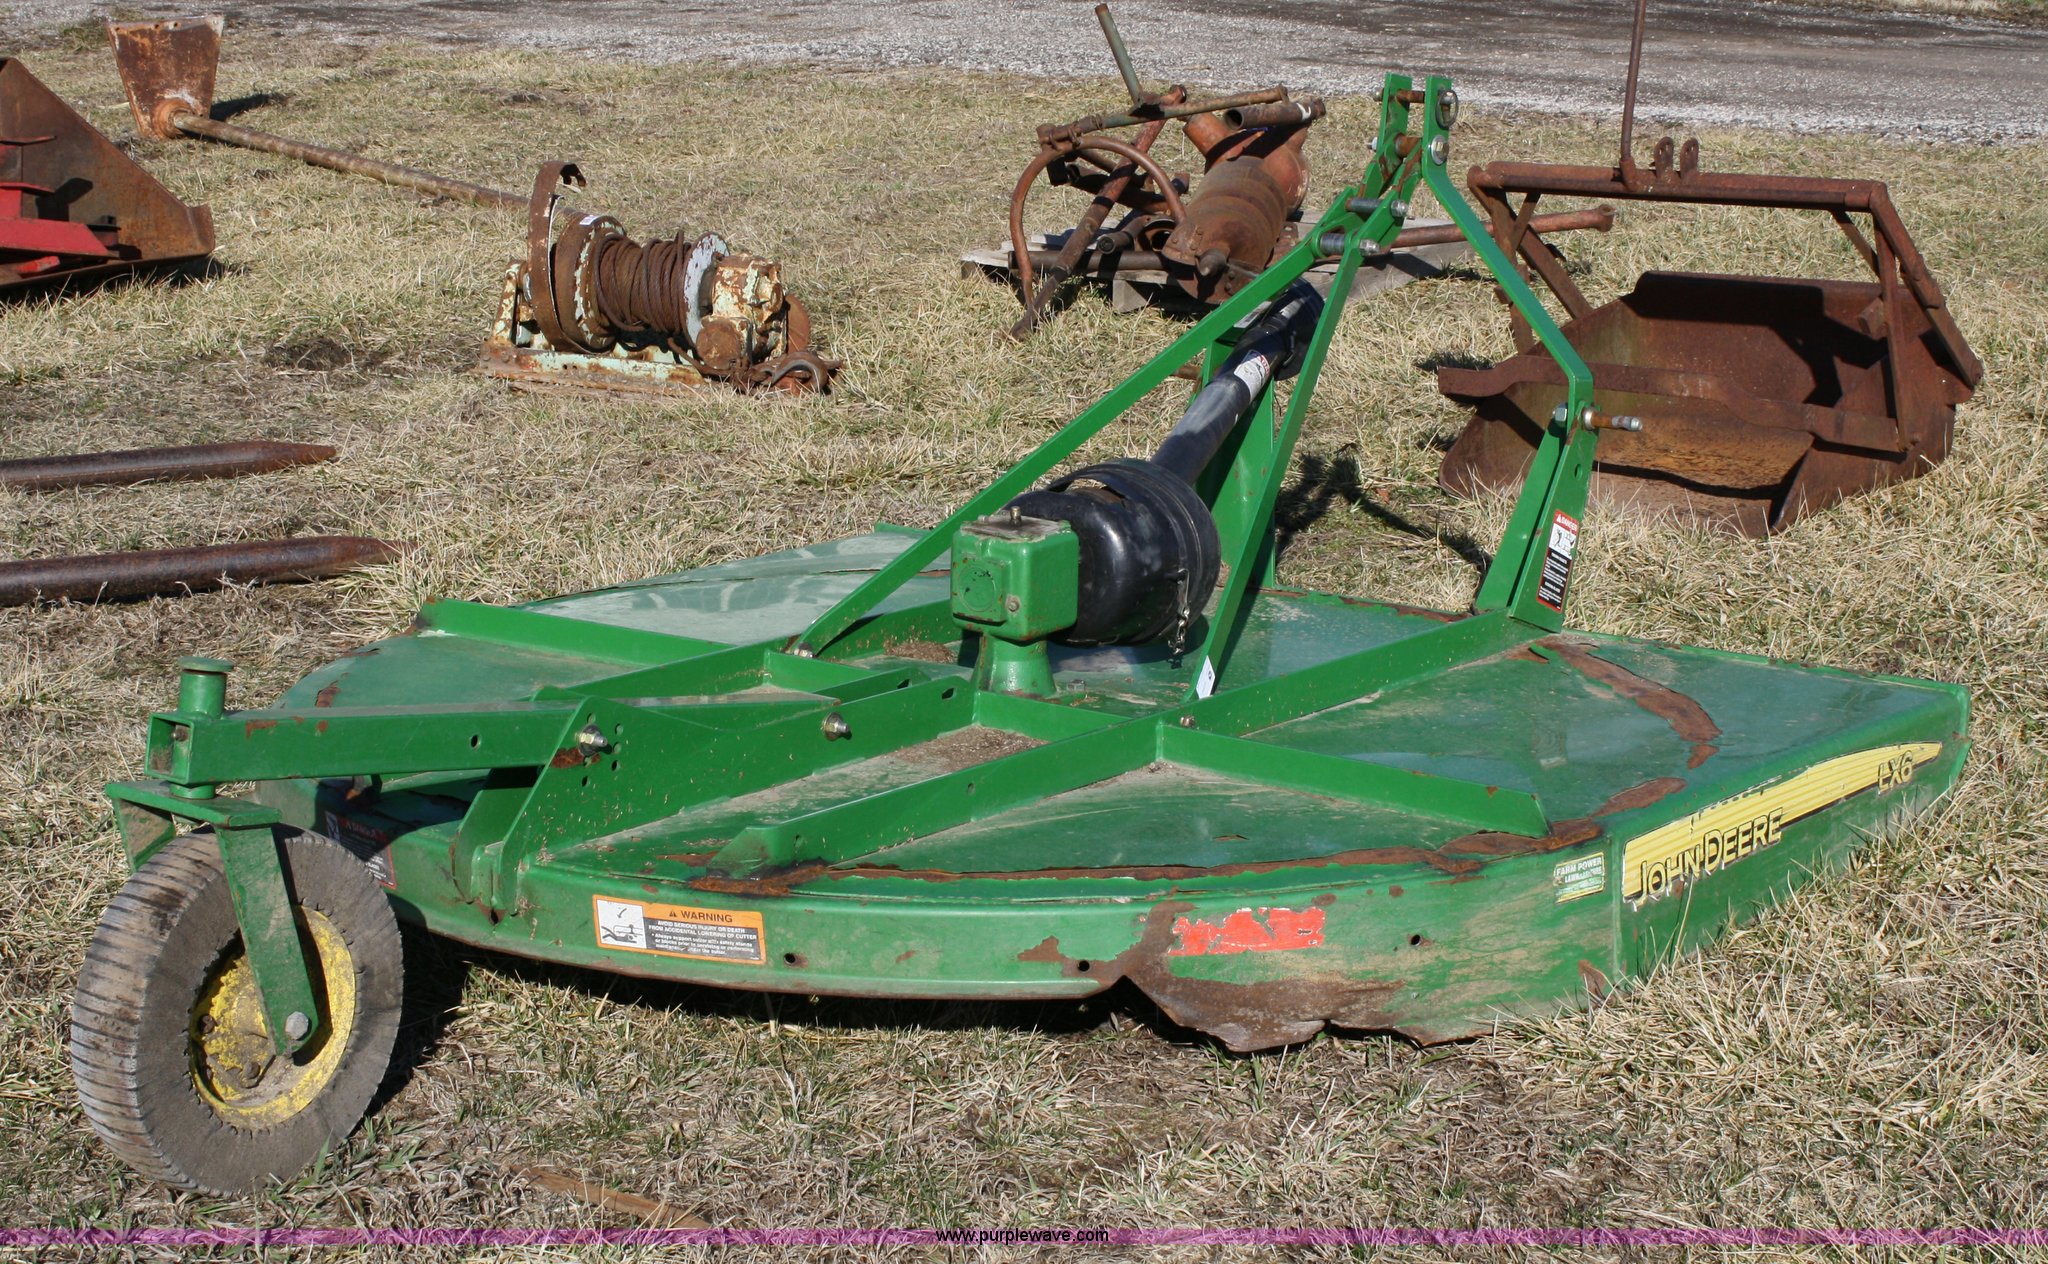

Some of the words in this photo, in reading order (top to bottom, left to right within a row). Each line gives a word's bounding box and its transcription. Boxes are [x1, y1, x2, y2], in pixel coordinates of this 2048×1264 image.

[1878, 750, 1912, 795] LX6
[1556, 864, 1577, 876] FARM
[1577, 857, 1602, 871] POWER
[1632, 842, 1701, 911] JOHN
[1703, 806, 1784, 877] DEERE
[674, 922, 698, 930] SERIOUS
[680, 910, 733, 923] WARNING
